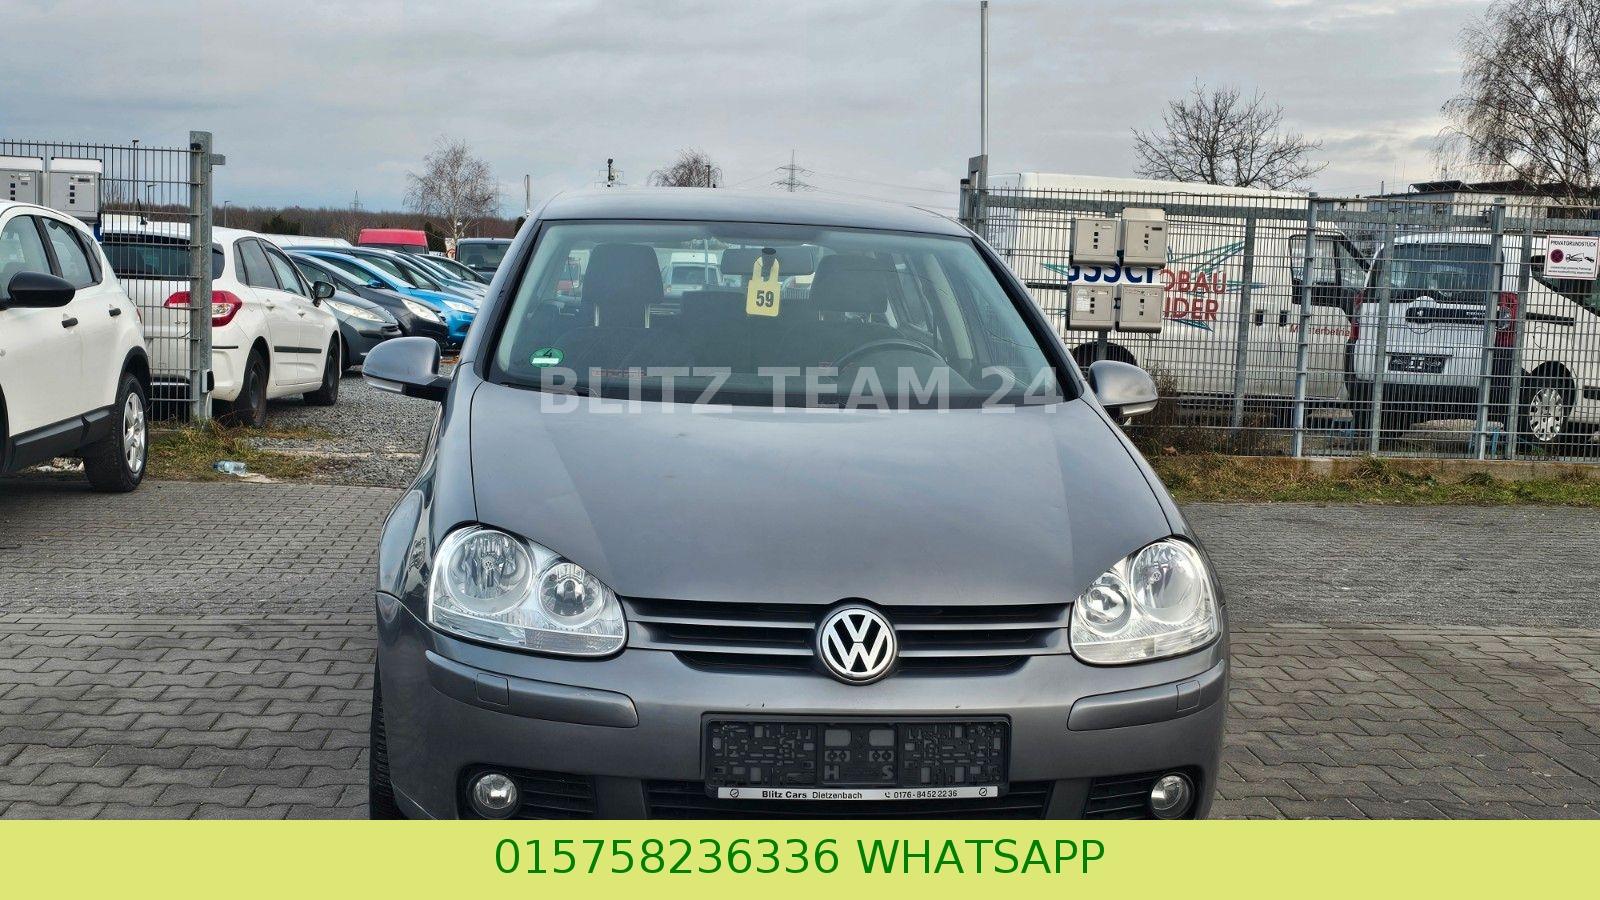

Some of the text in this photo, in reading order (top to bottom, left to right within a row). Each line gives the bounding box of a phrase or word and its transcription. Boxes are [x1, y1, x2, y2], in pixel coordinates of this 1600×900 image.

[755, 290, 775, 308] 59
[762, 790, 783, 798] Blitz
[785, 791, 807, 799] Cars
[812, 791, 863, 799] Dietzenbach
